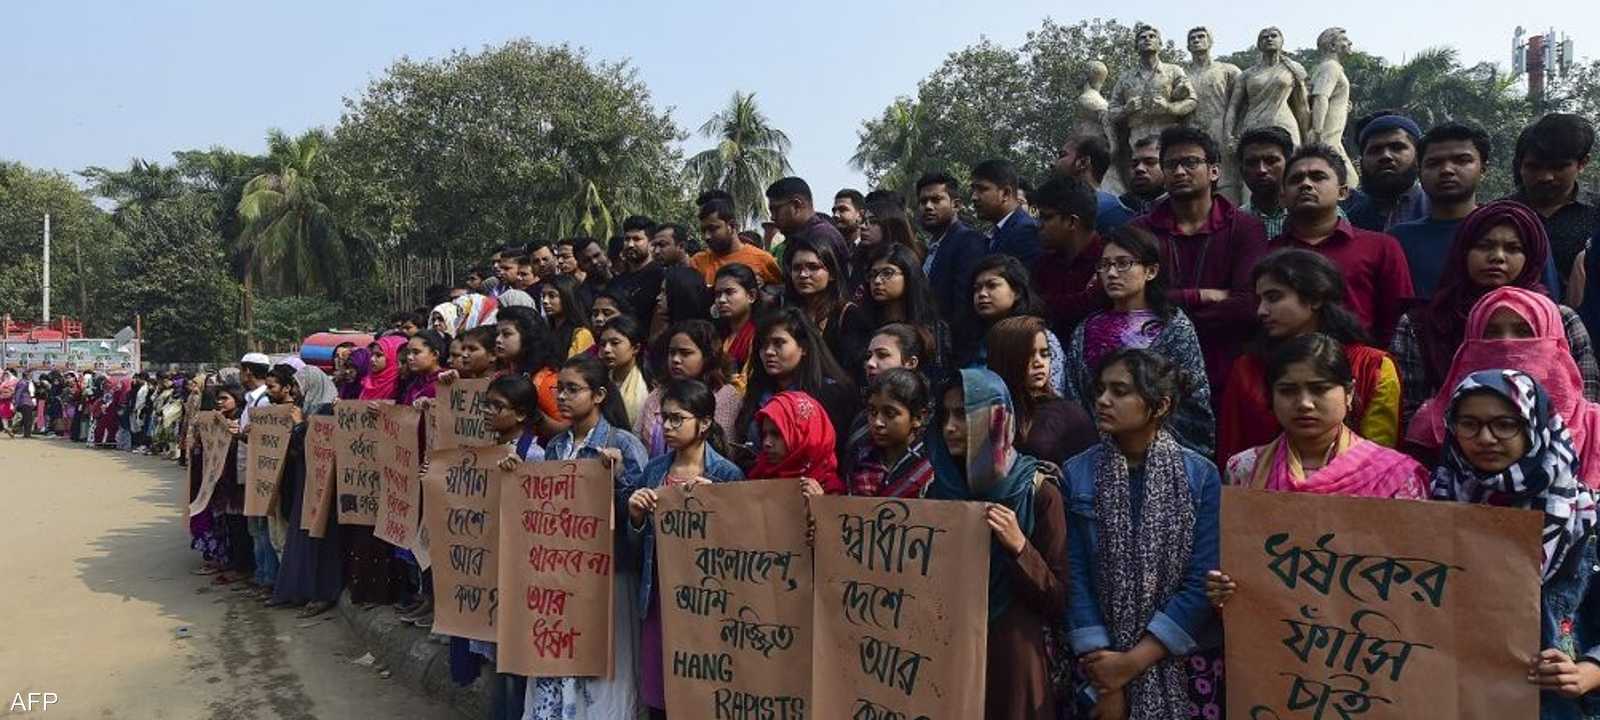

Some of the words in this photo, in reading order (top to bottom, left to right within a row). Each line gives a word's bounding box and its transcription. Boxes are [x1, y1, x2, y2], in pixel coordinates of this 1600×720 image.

[450, 384, 467, 412] WE
[445, 452, 494, 498] স্বাধীন
[446, 506, 492, 540] দেশে
[521, 500, 606, 541] অভিধানে
[660, 497, 715, 540] আমি
[838, 501, 947, 576] স্বাধীন
[449, 543, 492, 577] আর
[528, 545, 584, 578] থাকবে
[586, 552, 611, 577] না
[695, 547, 801, 591] বাংলাদেশ,
[1264, 532, 1465, 608] ধর্ষকের
[454, 583, 487, 615] কত
[526, 584, 575, 617] আর
[675, 575, 734, 616] আমি
[842, 579, 915, 630] দেশে
[532, 618, 581, 660] ধর্ষণ
[1280, 604, 1434, 682] ফাঁসি
[673, 650, 733, 683] HANG
[859, 635, 932, 696] আর
[712, 688, 804, 720] RAPISTS
[1280, 672, 1392, 720] চাই
